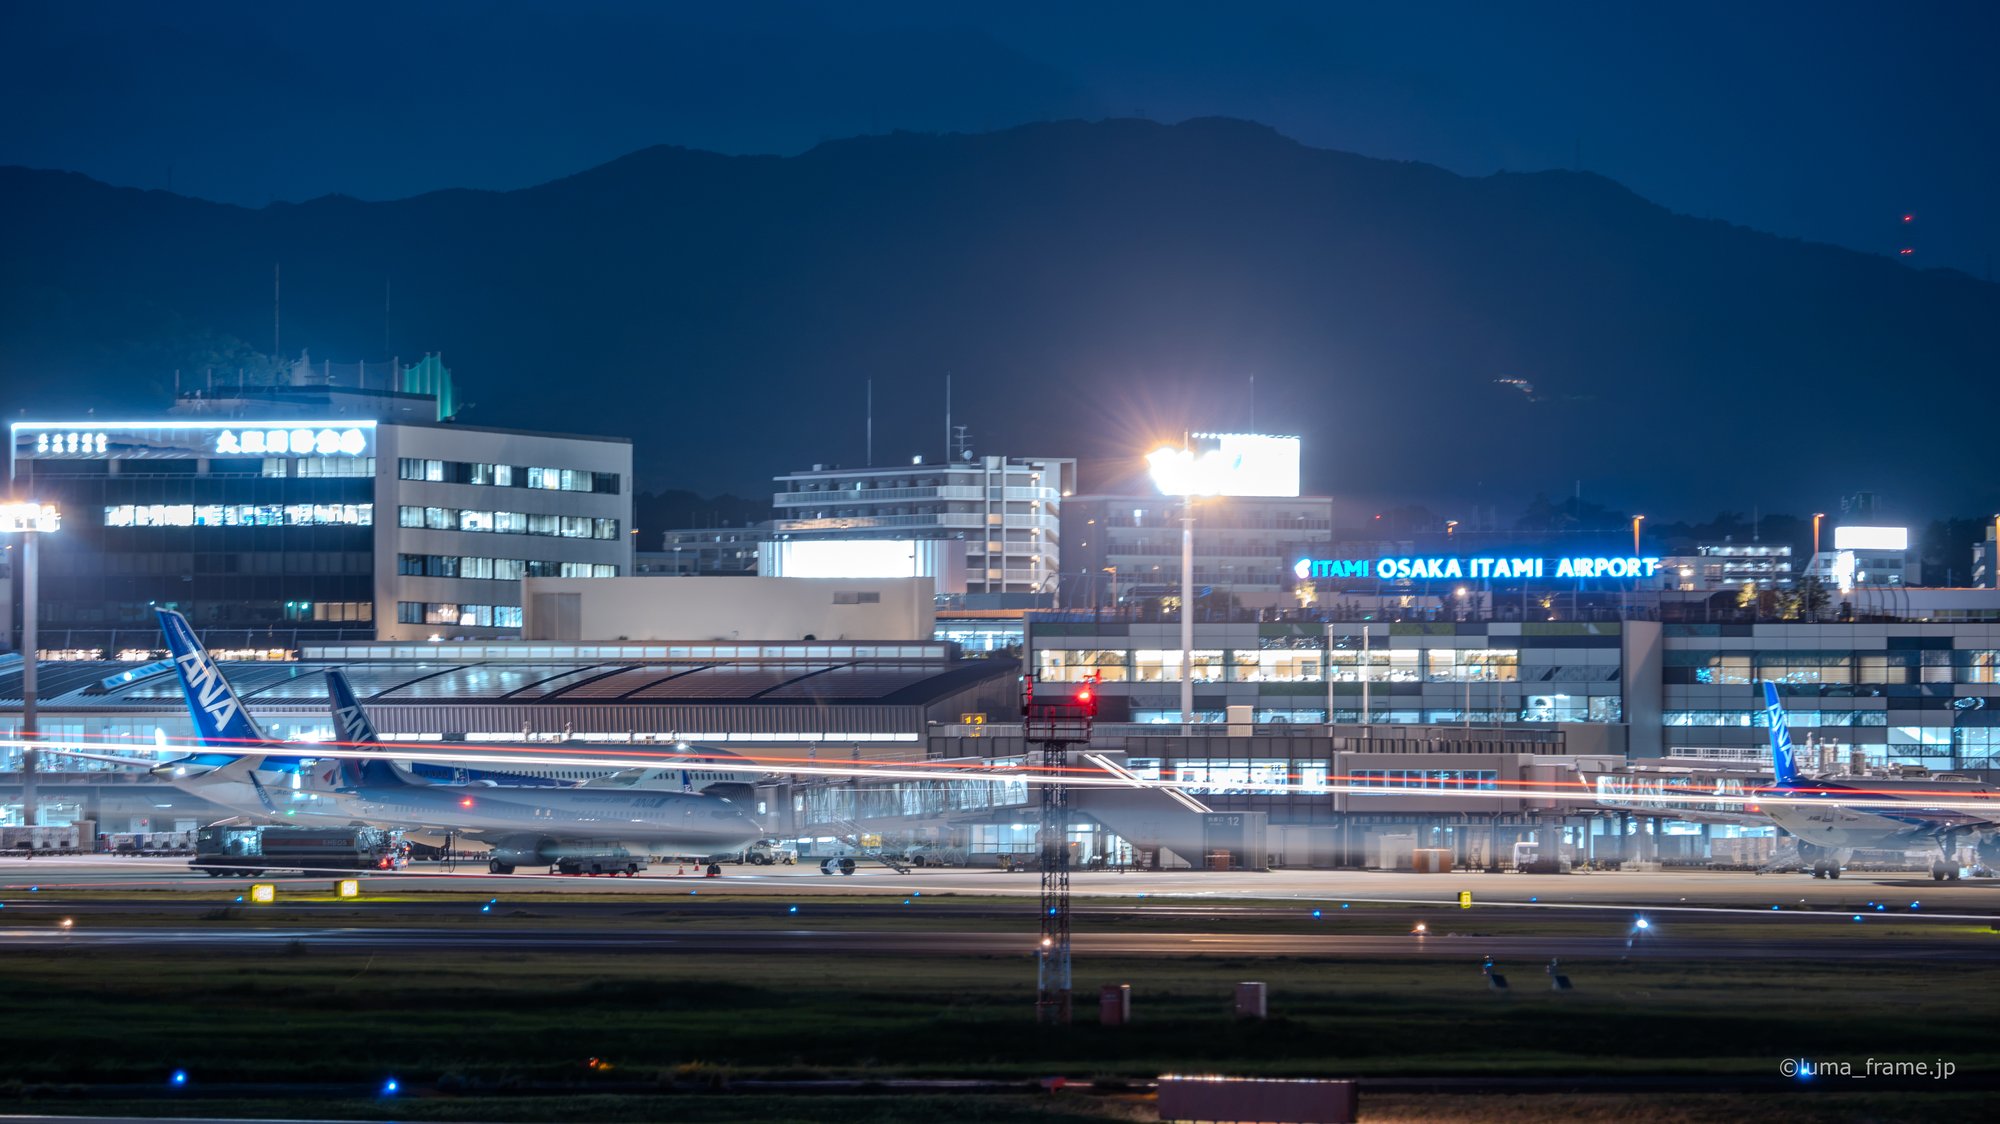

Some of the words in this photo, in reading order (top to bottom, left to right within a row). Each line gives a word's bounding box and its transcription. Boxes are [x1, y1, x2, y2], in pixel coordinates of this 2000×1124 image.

[1311, 559, 1369, 578] ITAMI
[1377, 557, 1463, 579] OSAKA
[1470, 557, 1543, 578] ITAMI
[1555, 556, 1660, 578] AIRPORT
[176, 649, 238, 732] ANA
[1767, 702, 1793, 768] ANA
[1227, 816, 1240, 826] 12
